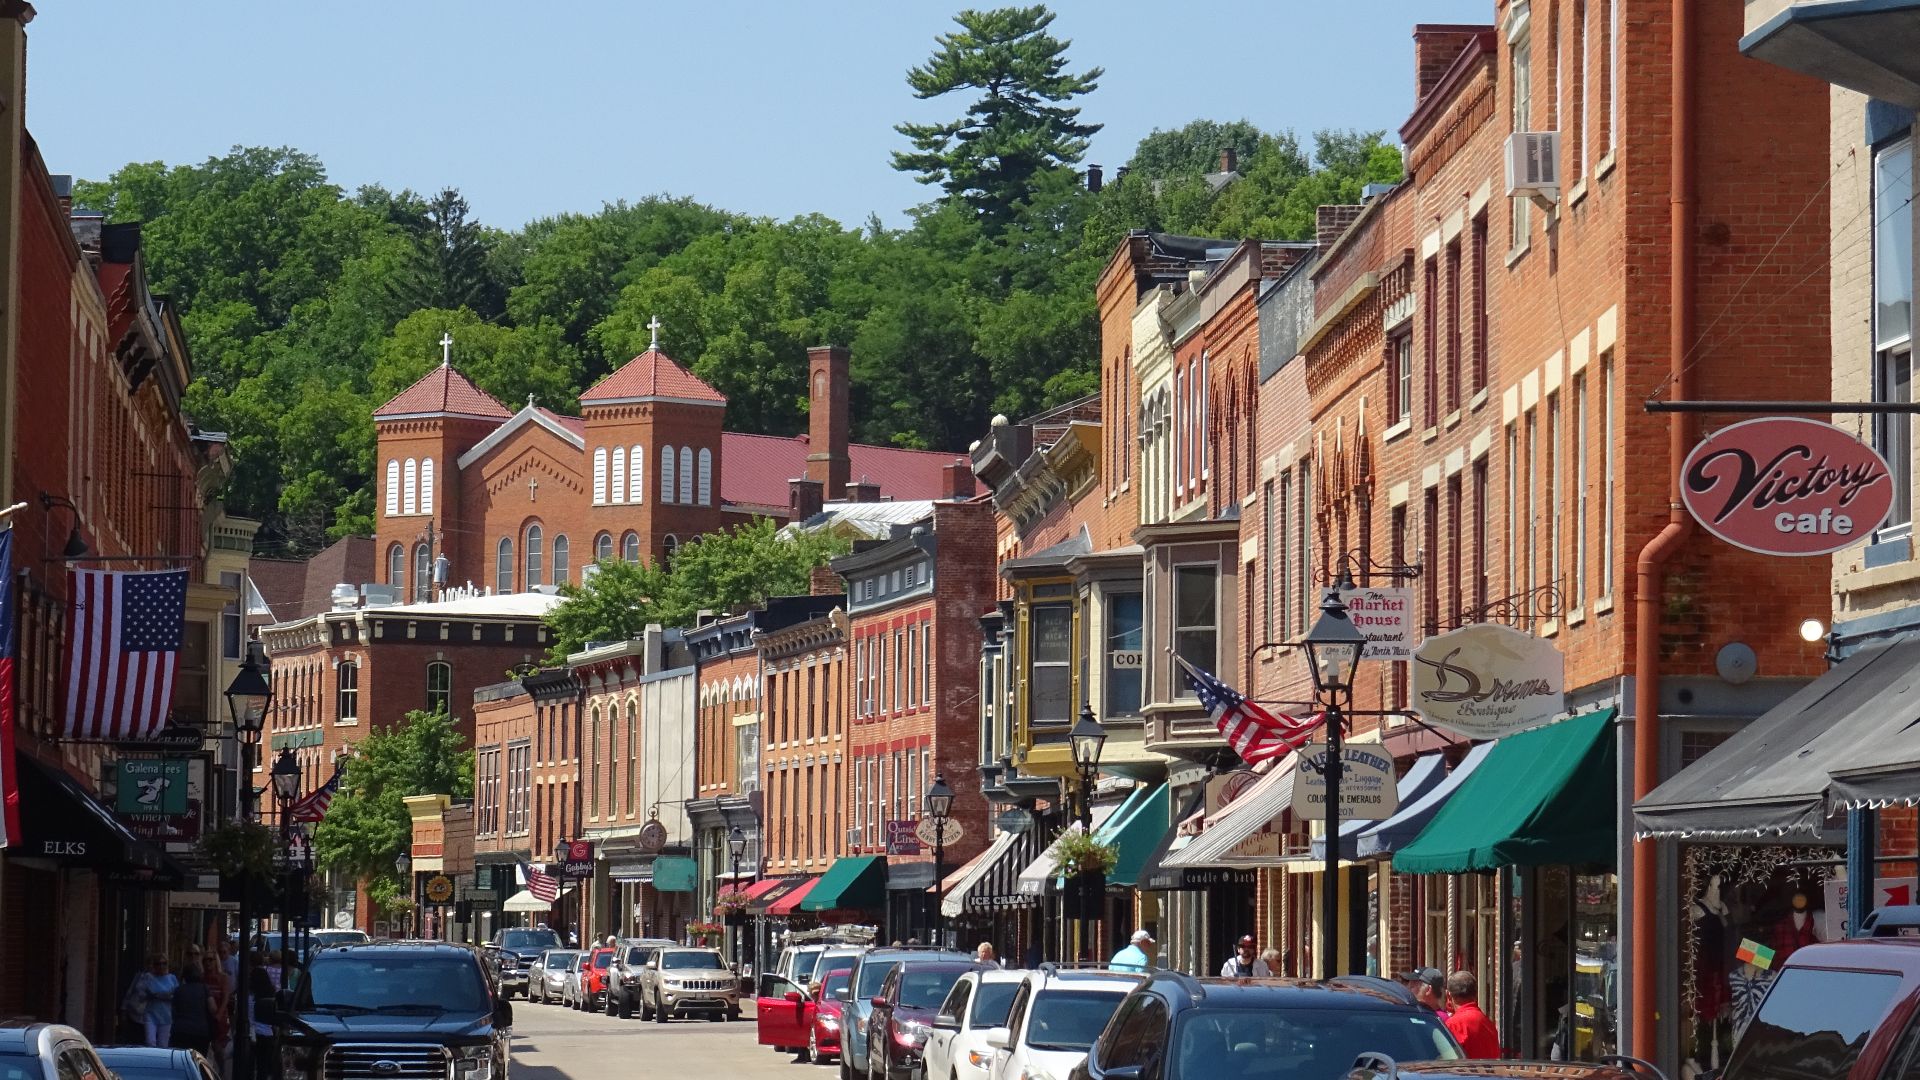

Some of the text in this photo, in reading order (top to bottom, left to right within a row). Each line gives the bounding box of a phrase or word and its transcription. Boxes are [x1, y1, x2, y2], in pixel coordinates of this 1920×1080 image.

[1687, 444, 1889, 525] Victory
[1774, 507, 1854, 536] cafe
[1366, 591, 1385, 601] The
[1348, 597, 1404, 612] Market
[1415, 646, 1560, 703] Dreams
[1456, 701, 1517, 721] Boutique
[125, 762, 159, 774] Galena
[1347, 794, 1382, 804] EMERALDS
[44, 841, 86, 855] ELKS
[566, 861, 593, 875] Gabby's
[1186, 871, 1218, 883] candle
[1234, 871, 1255, 883] bath
[971, 894, 1035, 906] ICE CREAM
